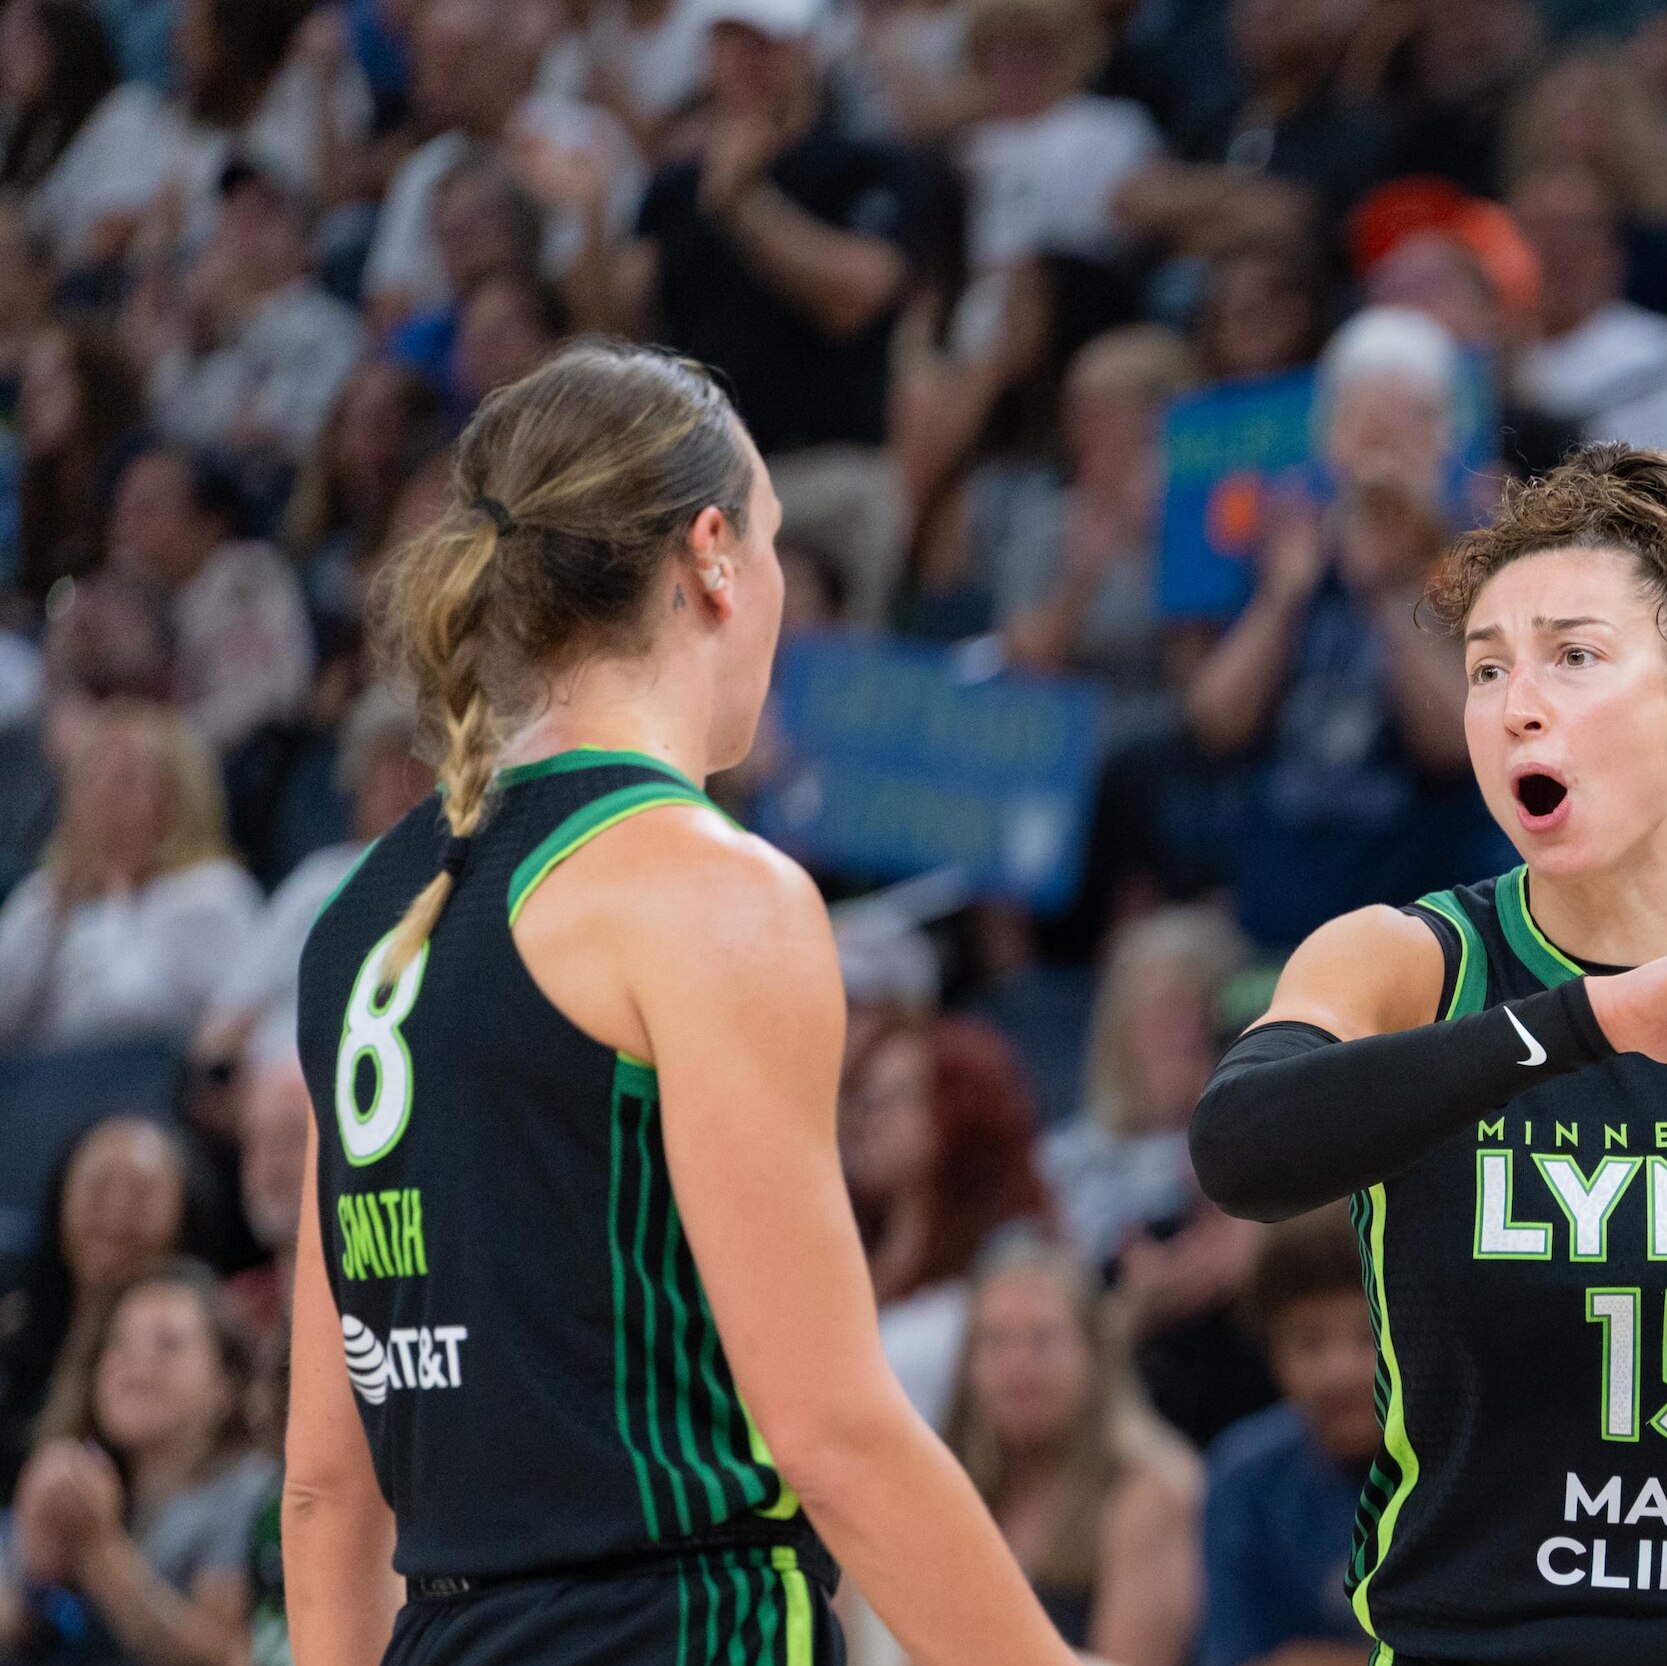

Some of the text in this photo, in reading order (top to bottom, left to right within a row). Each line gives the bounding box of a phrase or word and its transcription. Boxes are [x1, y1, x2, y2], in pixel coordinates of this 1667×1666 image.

[335, 924, 431, 1167] 8
[338, 1188, 428, 1281] SMITH
[386, 1325, 468, 1390] AT&T
